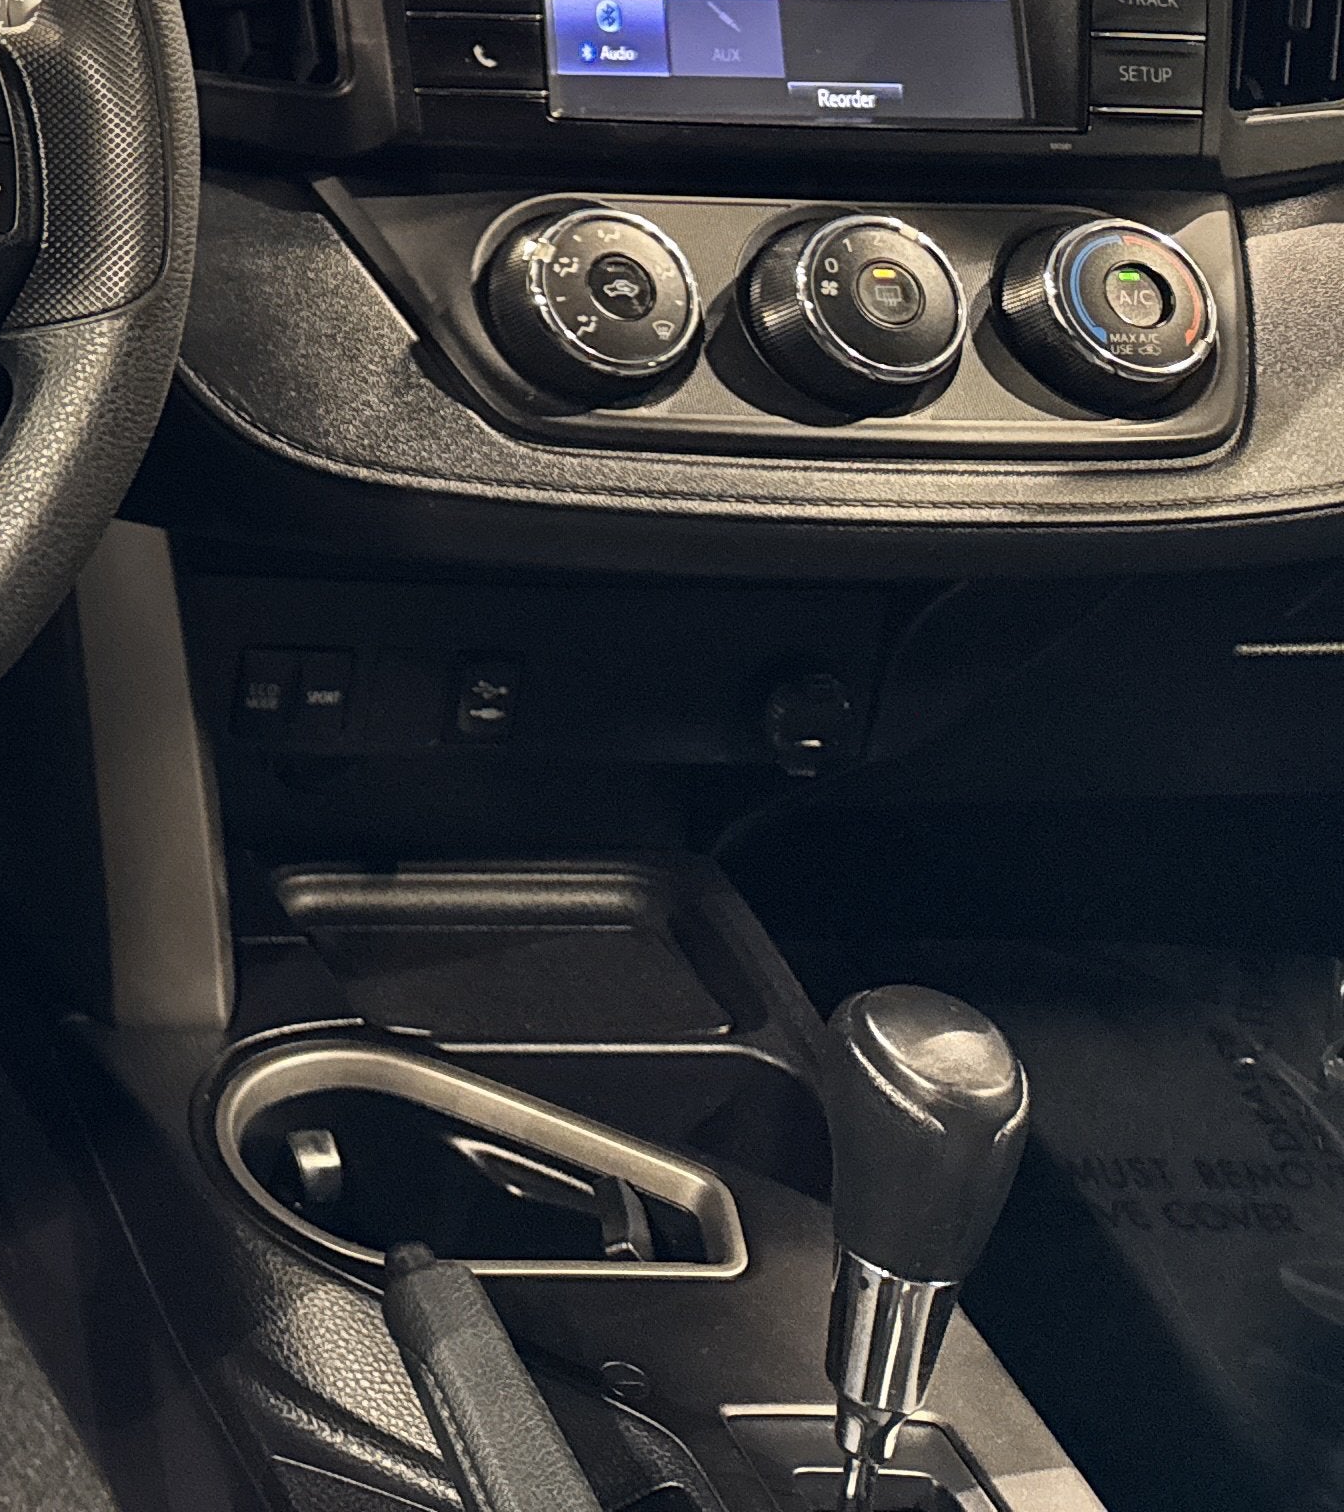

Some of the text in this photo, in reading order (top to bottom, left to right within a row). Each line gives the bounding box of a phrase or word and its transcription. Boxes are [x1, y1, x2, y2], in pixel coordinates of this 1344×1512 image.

[600, 46, 637, 62] Audio
[713, 49, 741, 62] AUX
[1119, 66, 1172, 83] SETUP
[818, 89, 875, 109] Reorder
[1119, 289, 1156, 306] A/C
[1109, 333, 1161, 344] MAX A/C
[1110, 345, 1134, 355] USE
